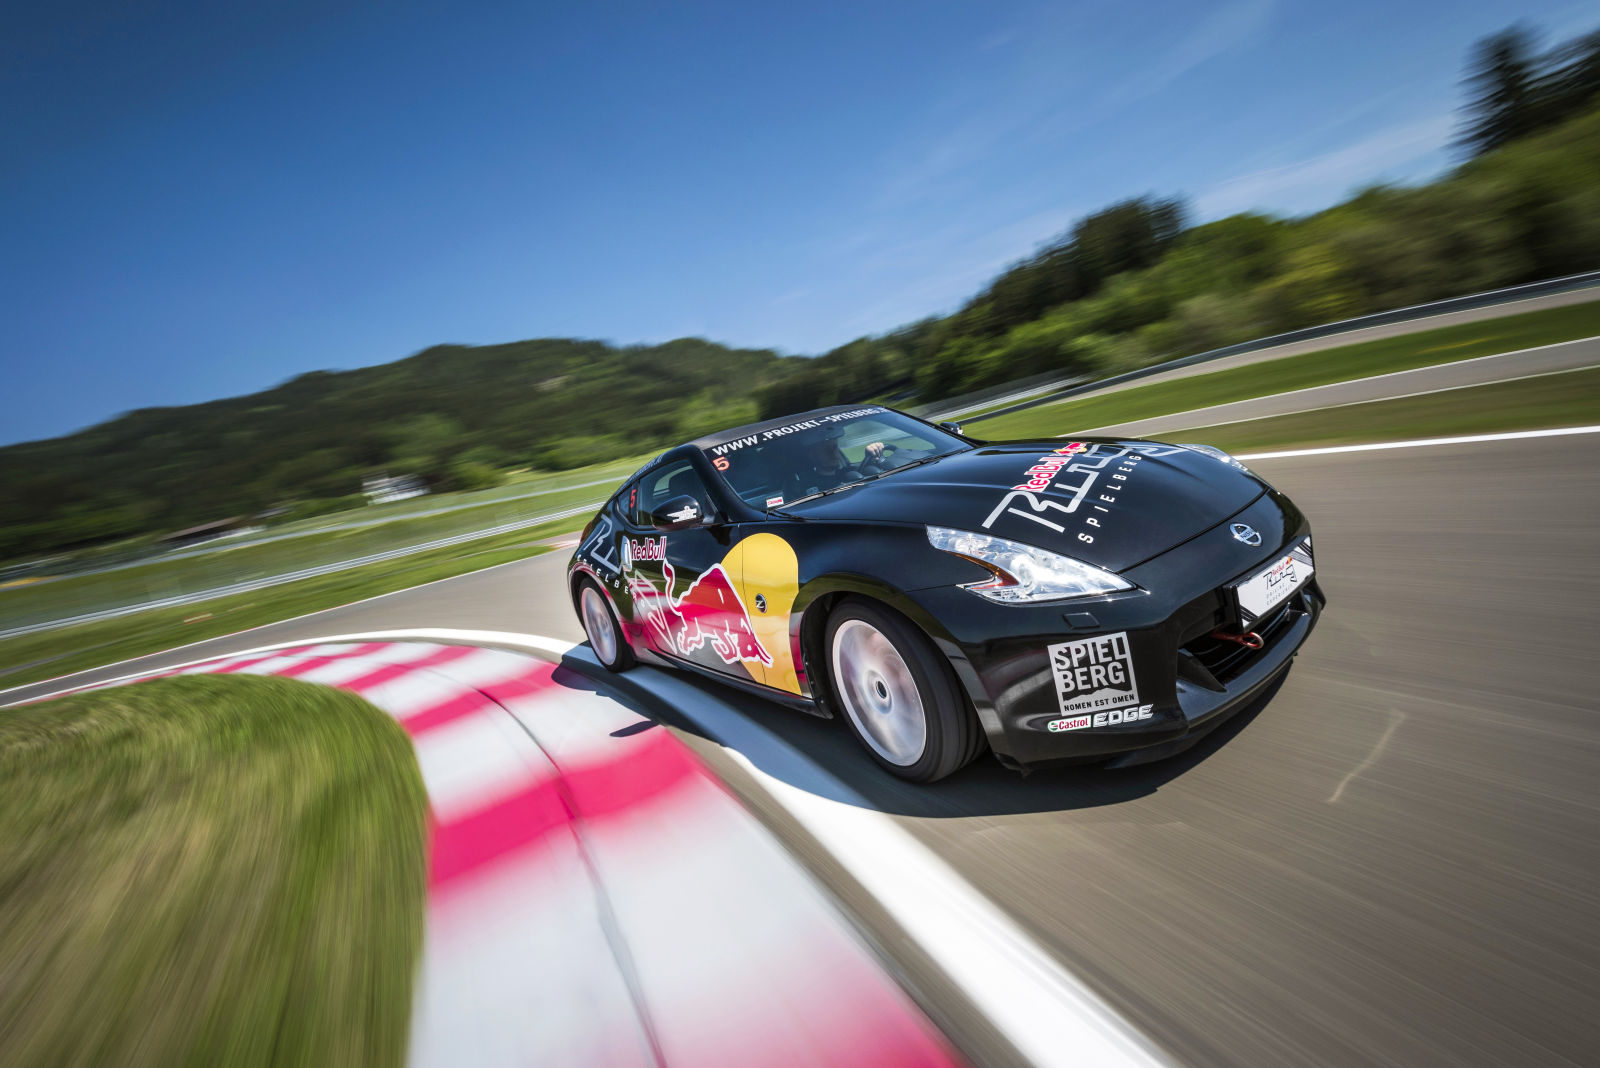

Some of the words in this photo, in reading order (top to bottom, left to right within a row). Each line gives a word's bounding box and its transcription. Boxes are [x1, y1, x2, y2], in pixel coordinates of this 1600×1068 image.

[712, 456, 730, 471] 5
[629, 489, 637, 508] 5
[1077, 455, 1142, 544] SPIELBERG
[1054, 637, 1127, 670] SPIEL
[1058, 661, 1126, 693] BERG
[1064, 701, 1092, 712] NOMEN
[1095, 698, 1109, 707] EST
[1112, 693, 1135, 704] OMEN
[1058, 717, 1089, 730] Castrol
[1093, 704, 1154, 728] EDGE
